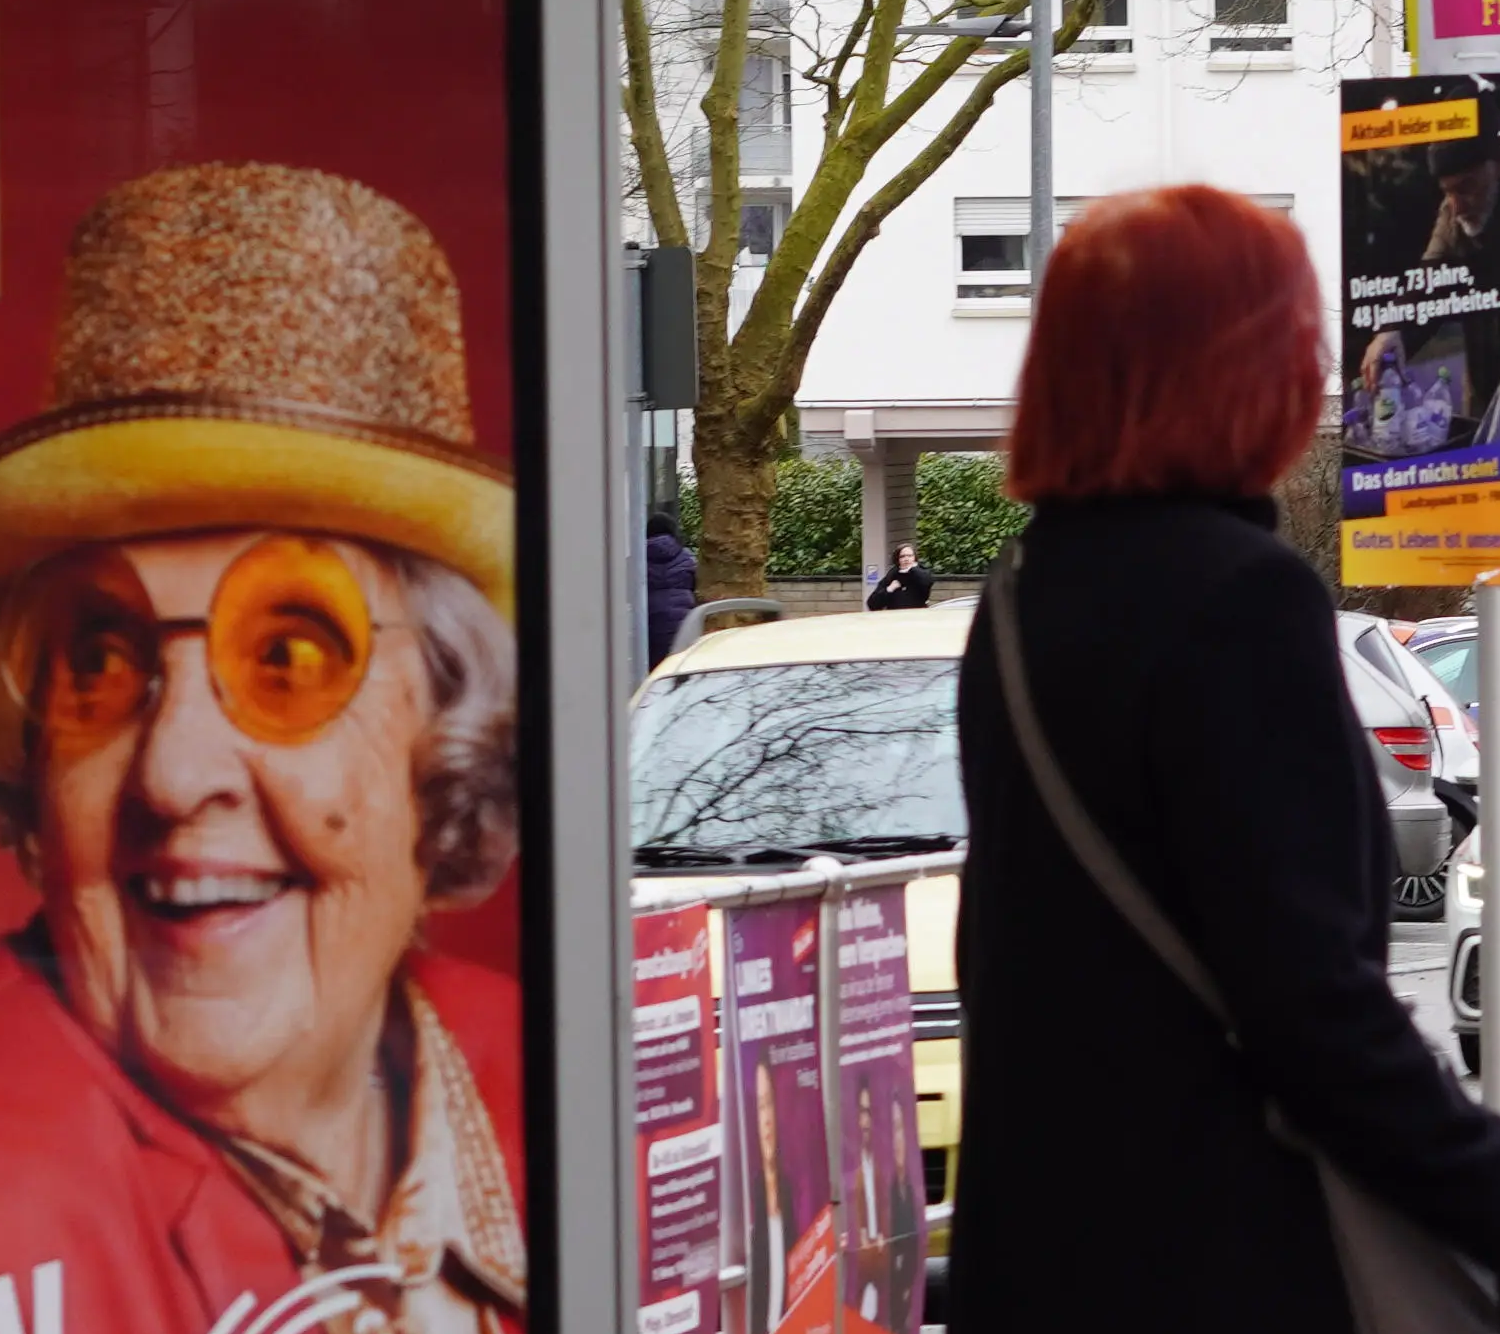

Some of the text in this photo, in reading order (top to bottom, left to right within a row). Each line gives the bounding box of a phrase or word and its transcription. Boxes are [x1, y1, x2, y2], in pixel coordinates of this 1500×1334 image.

[1351, 117, 1395, 141] Aktuell
[1351, 263, 1474, 301] Dieter, 73 Jahre,
[1352, 304, 1371, 329] 48
[1372, 299, 1414, 330] Jahre
[1352, 471, 1381, 492] Das
[1384, 464, 1417, 489] darf
[1419, 460, 1459, 485] nicht
